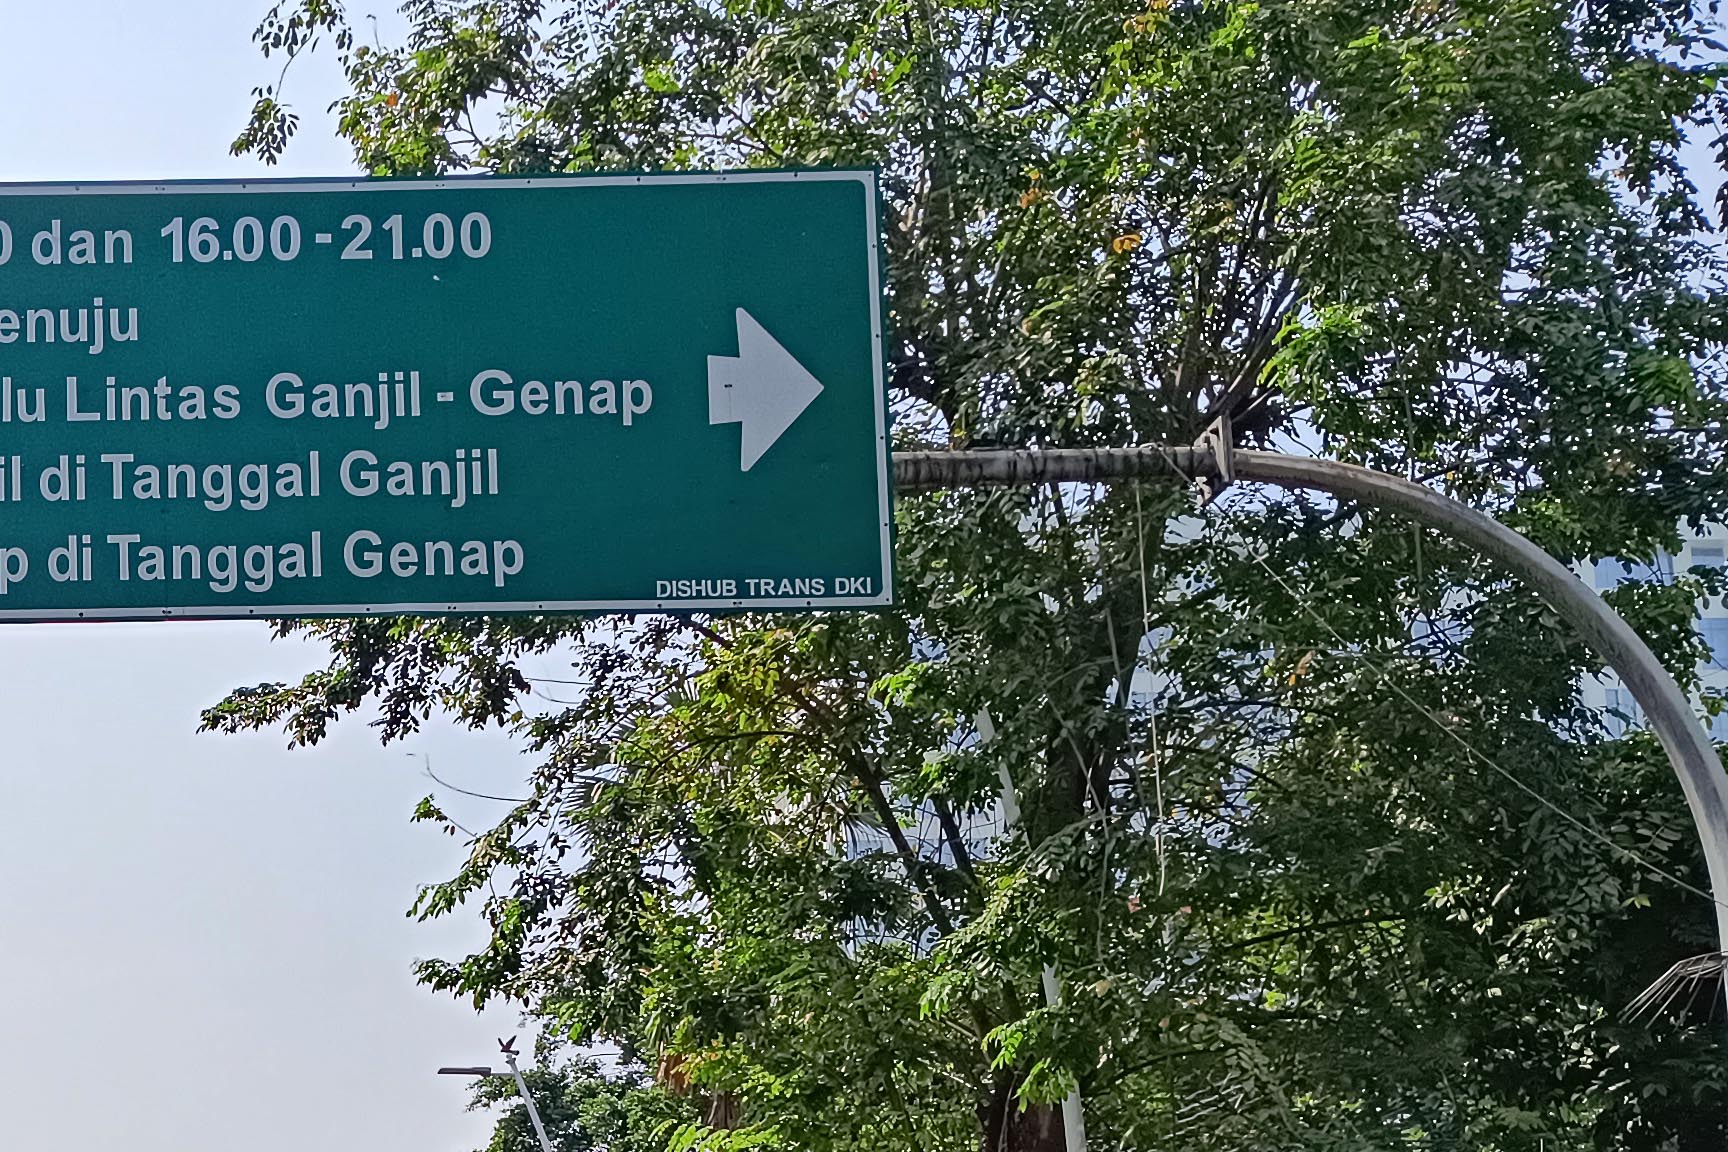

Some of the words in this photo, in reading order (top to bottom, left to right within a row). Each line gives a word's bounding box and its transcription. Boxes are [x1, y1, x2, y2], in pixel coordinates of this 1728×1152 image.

[32, 219, 132, 265] dan
[67, 376, 240, 421] Lintas
[40, 455, 85, 501] di
[101, 451, 319, 511] Tanggal
[340, 449, 498, 507] Ganjil
[48, 535, 91, 581] di
[107, 531, 321, 592] Tanggal
[344, 530, 523, 587] Genap
[653, 580, 740, 602] DISHUB
[742, 579, 828, 600] TRANS
[831, 577, 875, 599] DKI
